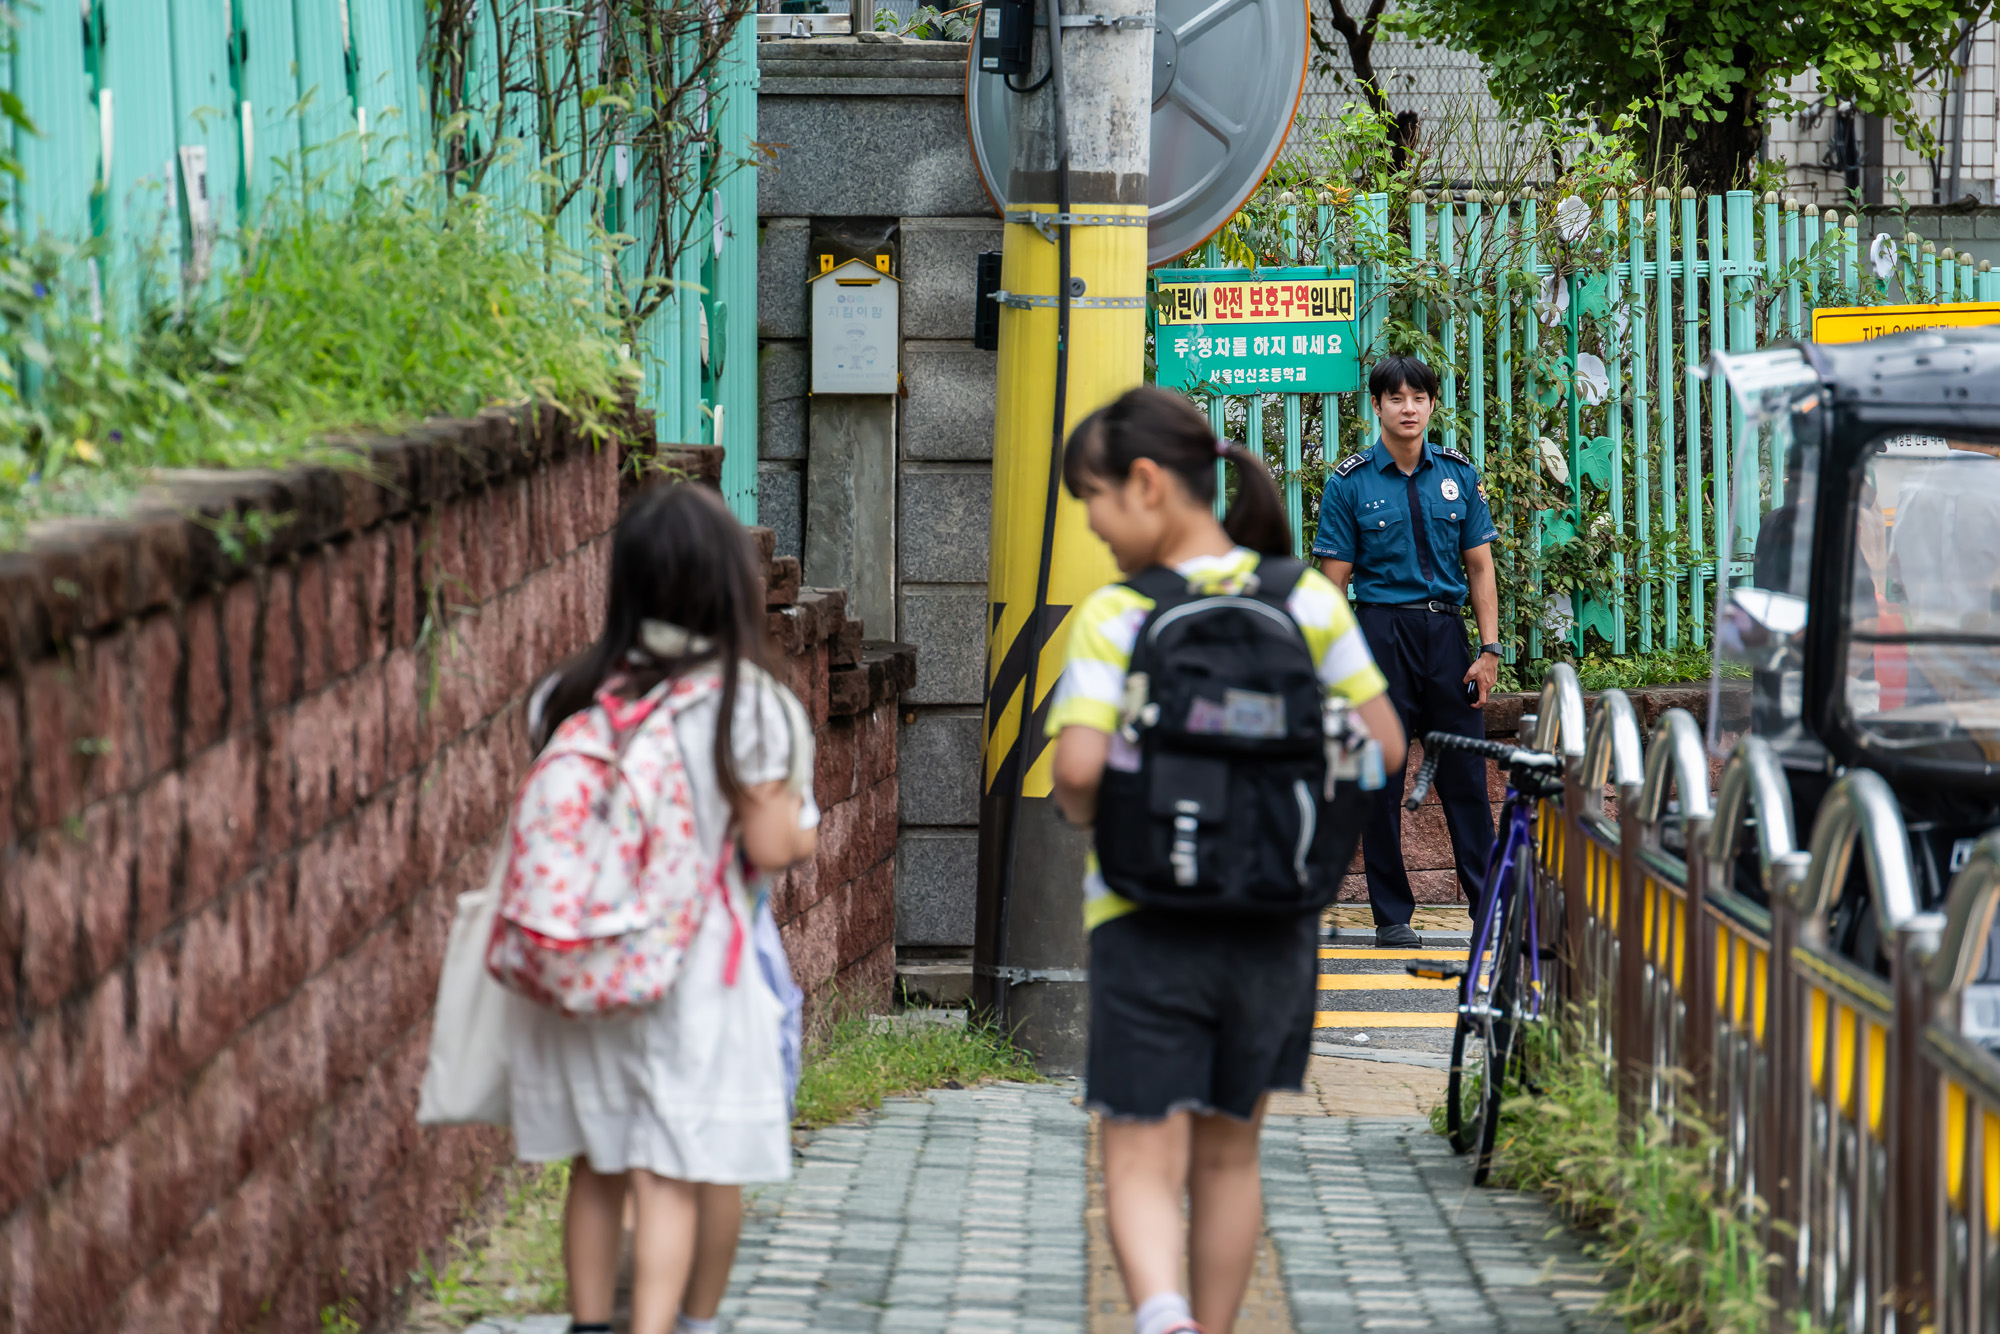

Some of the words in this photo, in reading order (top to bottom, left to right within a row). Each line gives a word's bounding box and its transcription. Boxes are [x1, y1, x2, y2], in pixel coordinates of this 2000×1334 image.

[1213, 286, 1243, 319] 안전
[1250, 285, 1352, 317] 보호구역입니다
[1174, 336, 1247, 359] 주·정차를
[1253, 335, 1286, 356] 하지
[1292, 334, 1342, 355] 마세요
[1209, 367, 1307, 384] 서울연신초등학교
